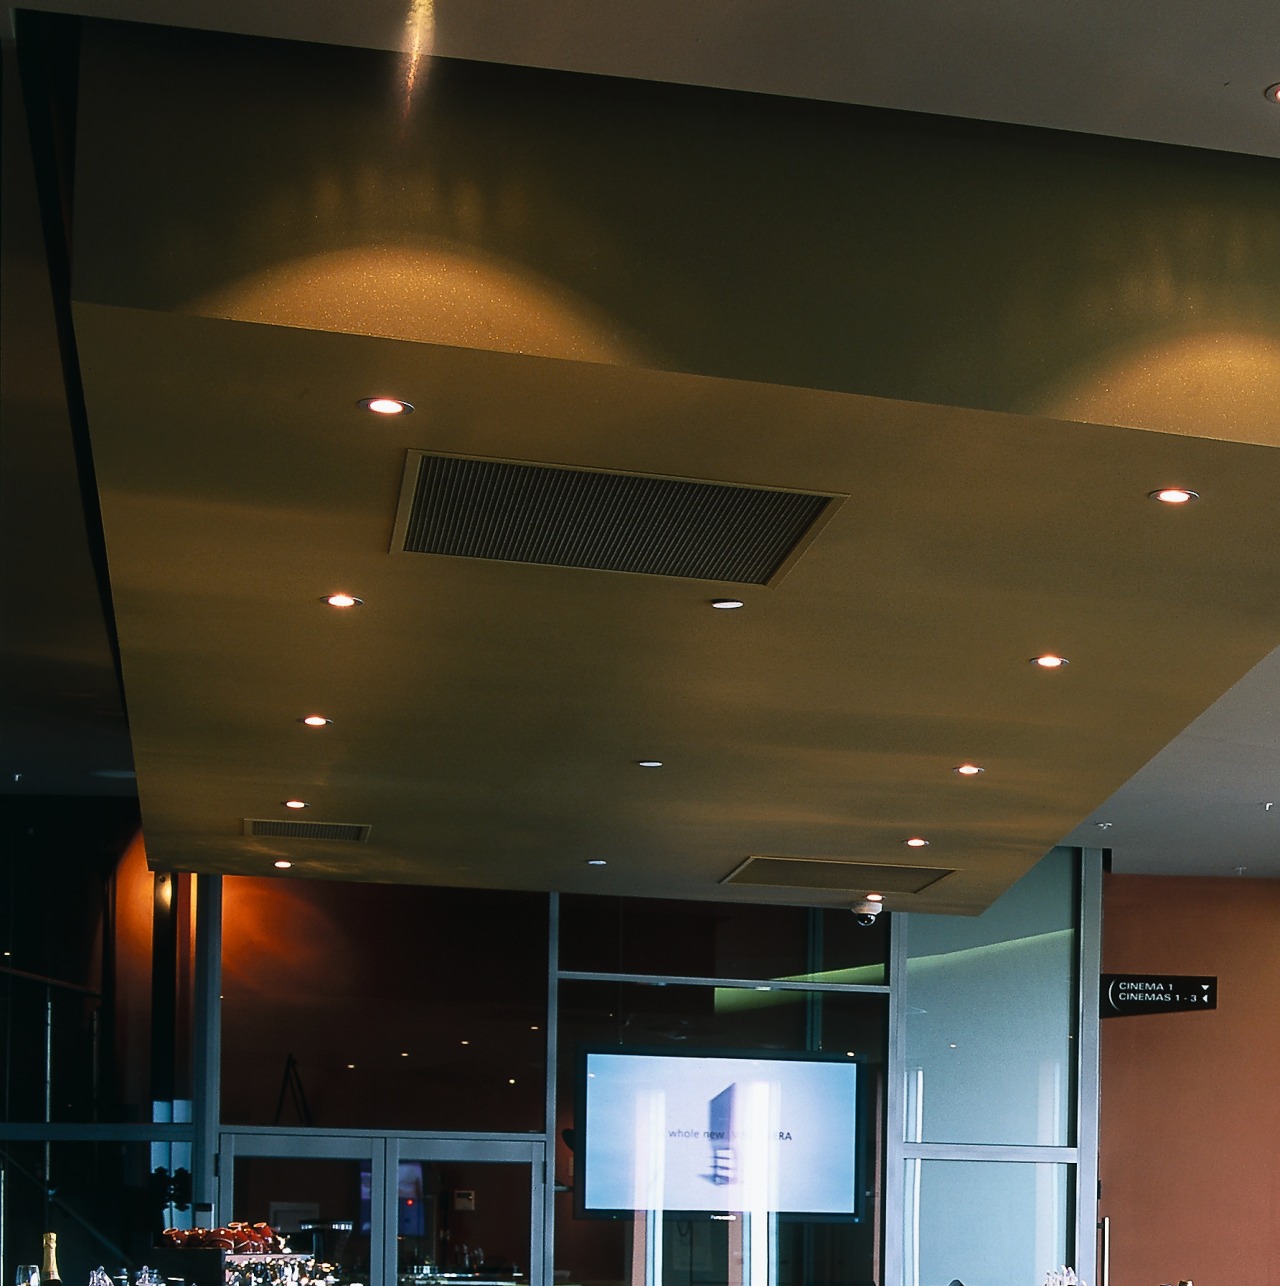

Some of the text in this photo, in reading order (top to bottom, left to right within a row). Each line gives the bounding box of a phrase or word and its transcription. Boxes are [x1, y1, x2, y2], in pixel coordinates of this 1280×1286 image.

[1118, 982, 1164, 990] CINEMA
[1118, 992, 1171, 1001] CINEMAS
[1190, 994, 1197, 1002] 3
[668, 1129, 700, 1139] whole
[703, 1130, 725, 1140] new
